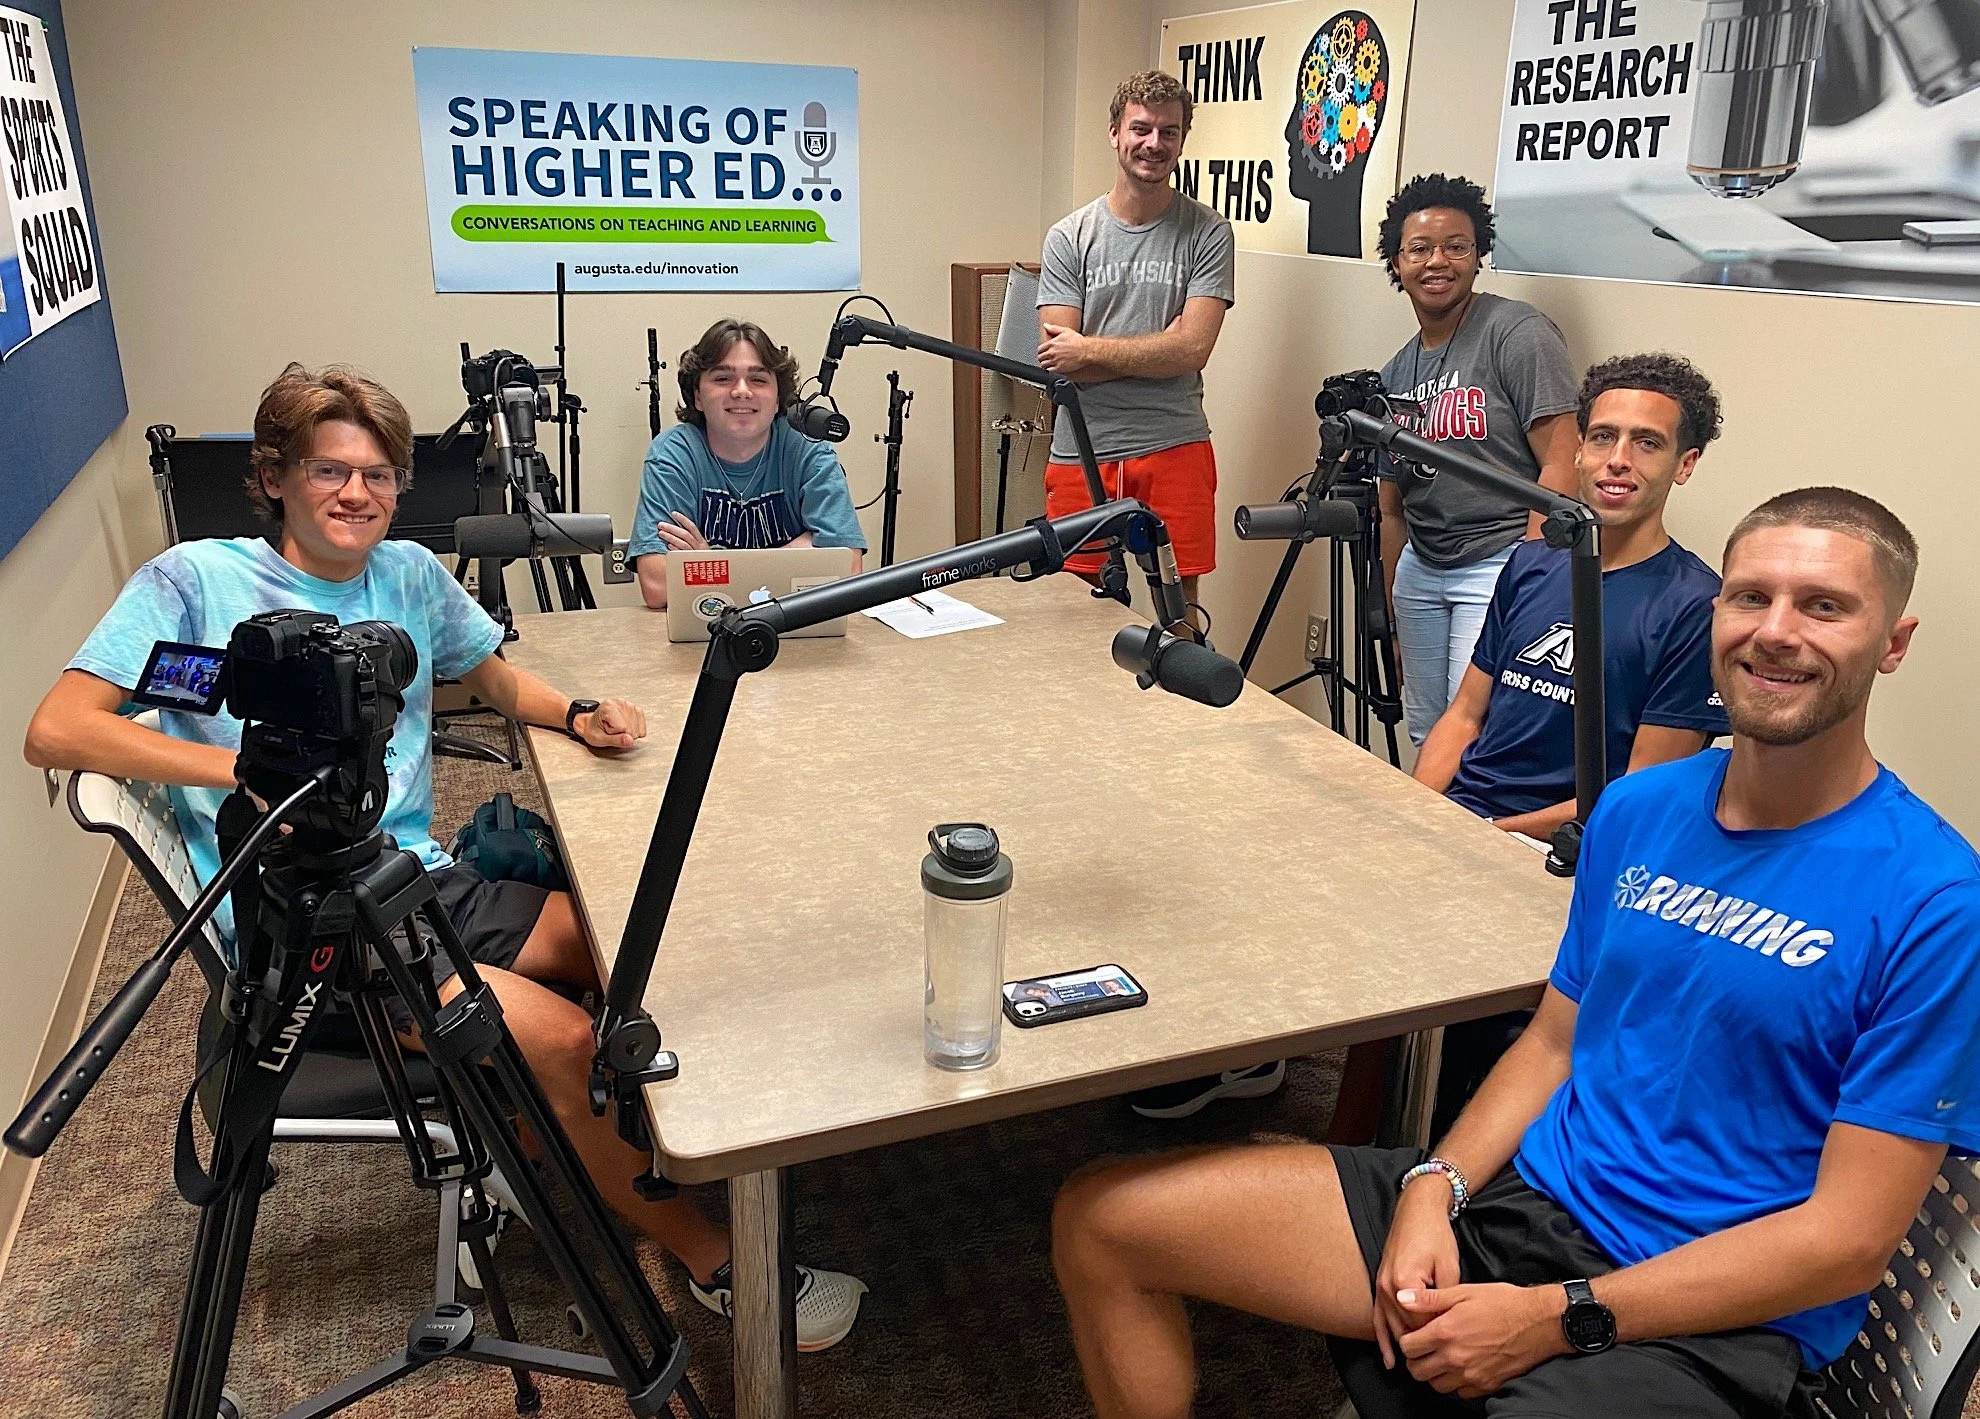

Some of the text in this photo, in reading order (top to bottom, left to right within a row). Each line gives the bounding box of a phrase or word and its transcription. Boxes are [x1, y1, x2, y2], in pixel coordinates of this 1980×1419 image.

[0, 16, 36, 83] THE
[1547, 0, 1637, 46] THE
[1178, 36, 1266, 103] THINK
[1510, 41, 1694, 107] RESEARCH
[1, 95, 67, 200] SPORTS
[447, 96, 788, 146] SPEAKING OF
[1515, 115, 1670, 162] REPORT
[451, 144, 697, 199] HIGHER
[1208, 159, 1274, 223] THIS
[463, 216, 817, 233] CONVERSATIONS ON TEACHING AND LEARNING
[21, 207, 94, 316] SQUAD
[574, 262, 739, 278] augusta.edu/innovation
[1532, 679, 1575, 706] COUNT
[1633, 875, 1835, 968] RUNNING
[257, 945, 334, 1073] LUMIX G
